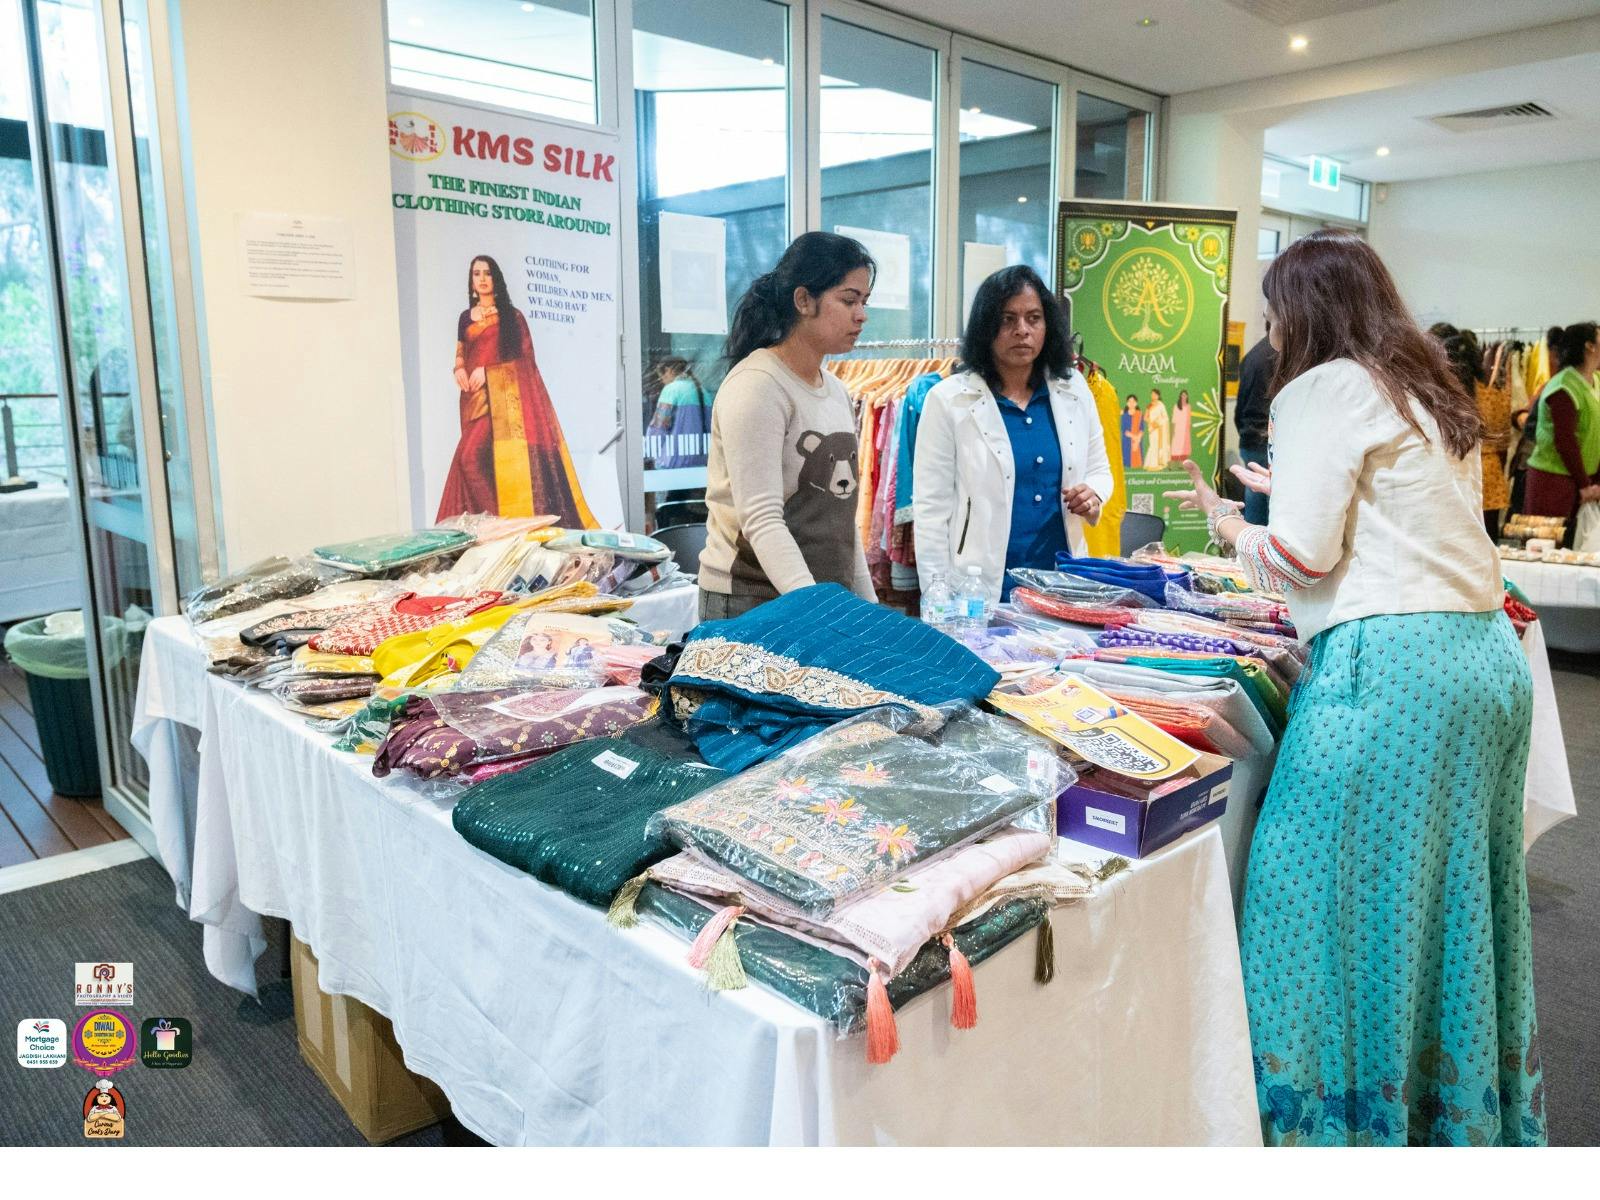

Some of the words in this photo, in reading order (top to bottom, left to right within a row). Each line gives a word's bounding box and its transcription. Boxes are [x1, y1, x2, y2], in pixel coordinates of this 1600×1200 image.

[452, 125, 535, 166] KMS
[543, 143, 615, 183] SILK
[428, 173, 466, 192] THE
[469, 180, 529, 201] FINEST
[532, 189, 582, 211] INDIAN
[392, 193, 488, 218] CLOTHING
[491, 204, 545, 224] STORE
[546, 212, 611, 236] AROUND!
[525, 255, 568, 272] CLOTHING
[570, 263, 590, 274] FOR
[527, 282, 568, 297] CHILDREN
[569, 289, 589, 300] AND
[528, 296, 543, 306] WE
[545, 298, 564, 309] ALSO
[564, 301, 587, 312] HAVE
[529, 309, 576, 324] JEWELLERY
[1118, 353, 1177, 374] AALAM
